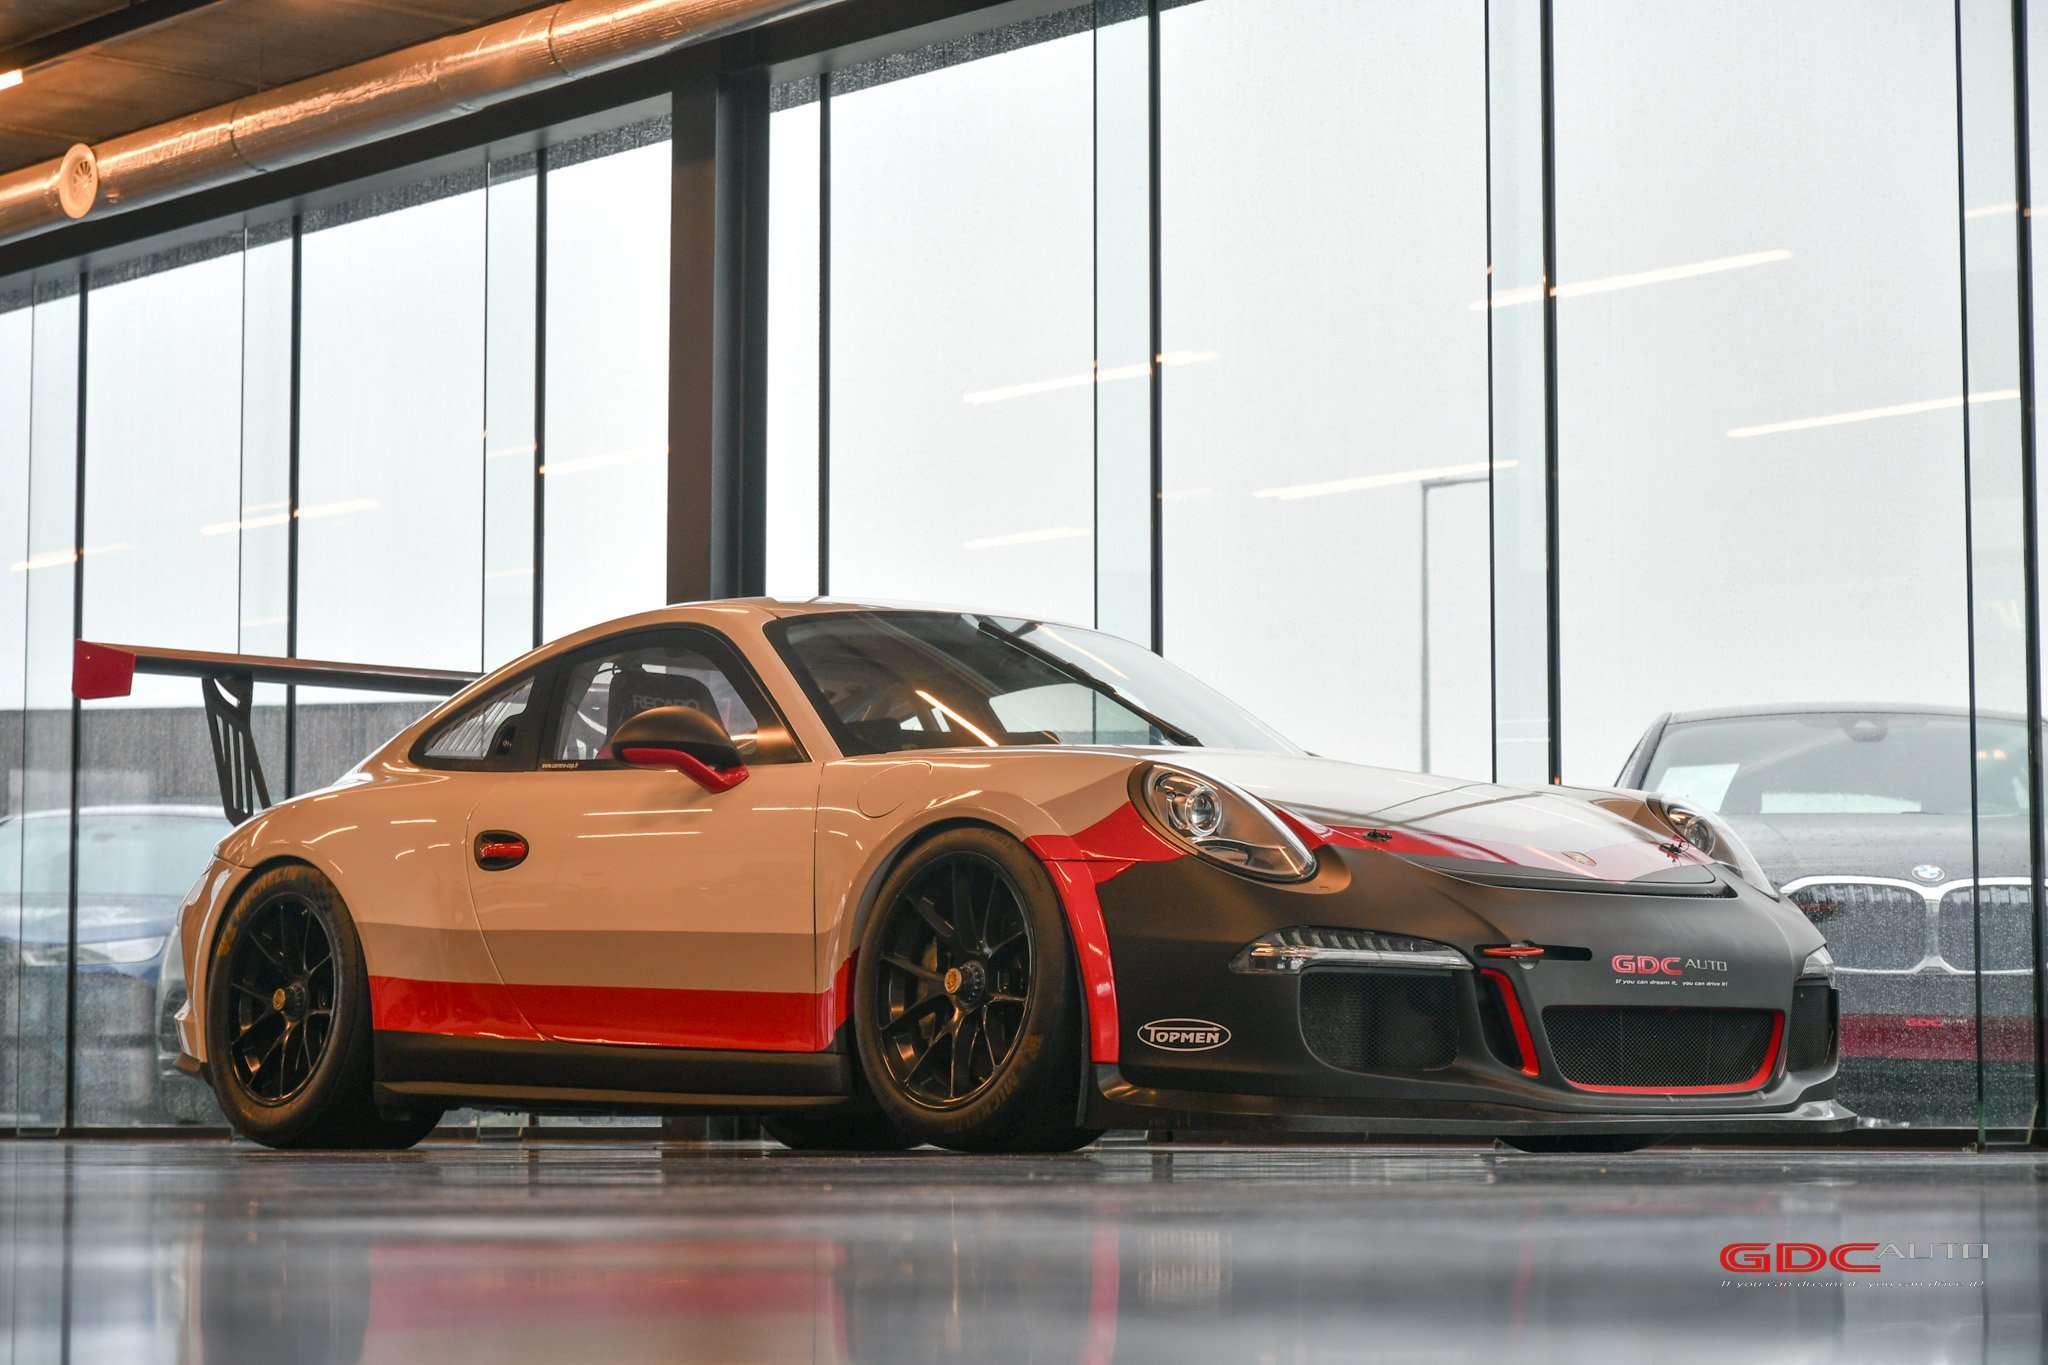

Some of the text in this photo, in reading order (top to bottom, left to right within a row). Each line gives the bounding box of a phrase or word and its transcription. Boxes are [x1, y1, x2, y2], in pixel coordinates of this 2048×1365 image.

[1611, 954, 1728, 976] GDC AUTO
[1144, 1026, 1221, 1044] TOPMEN
